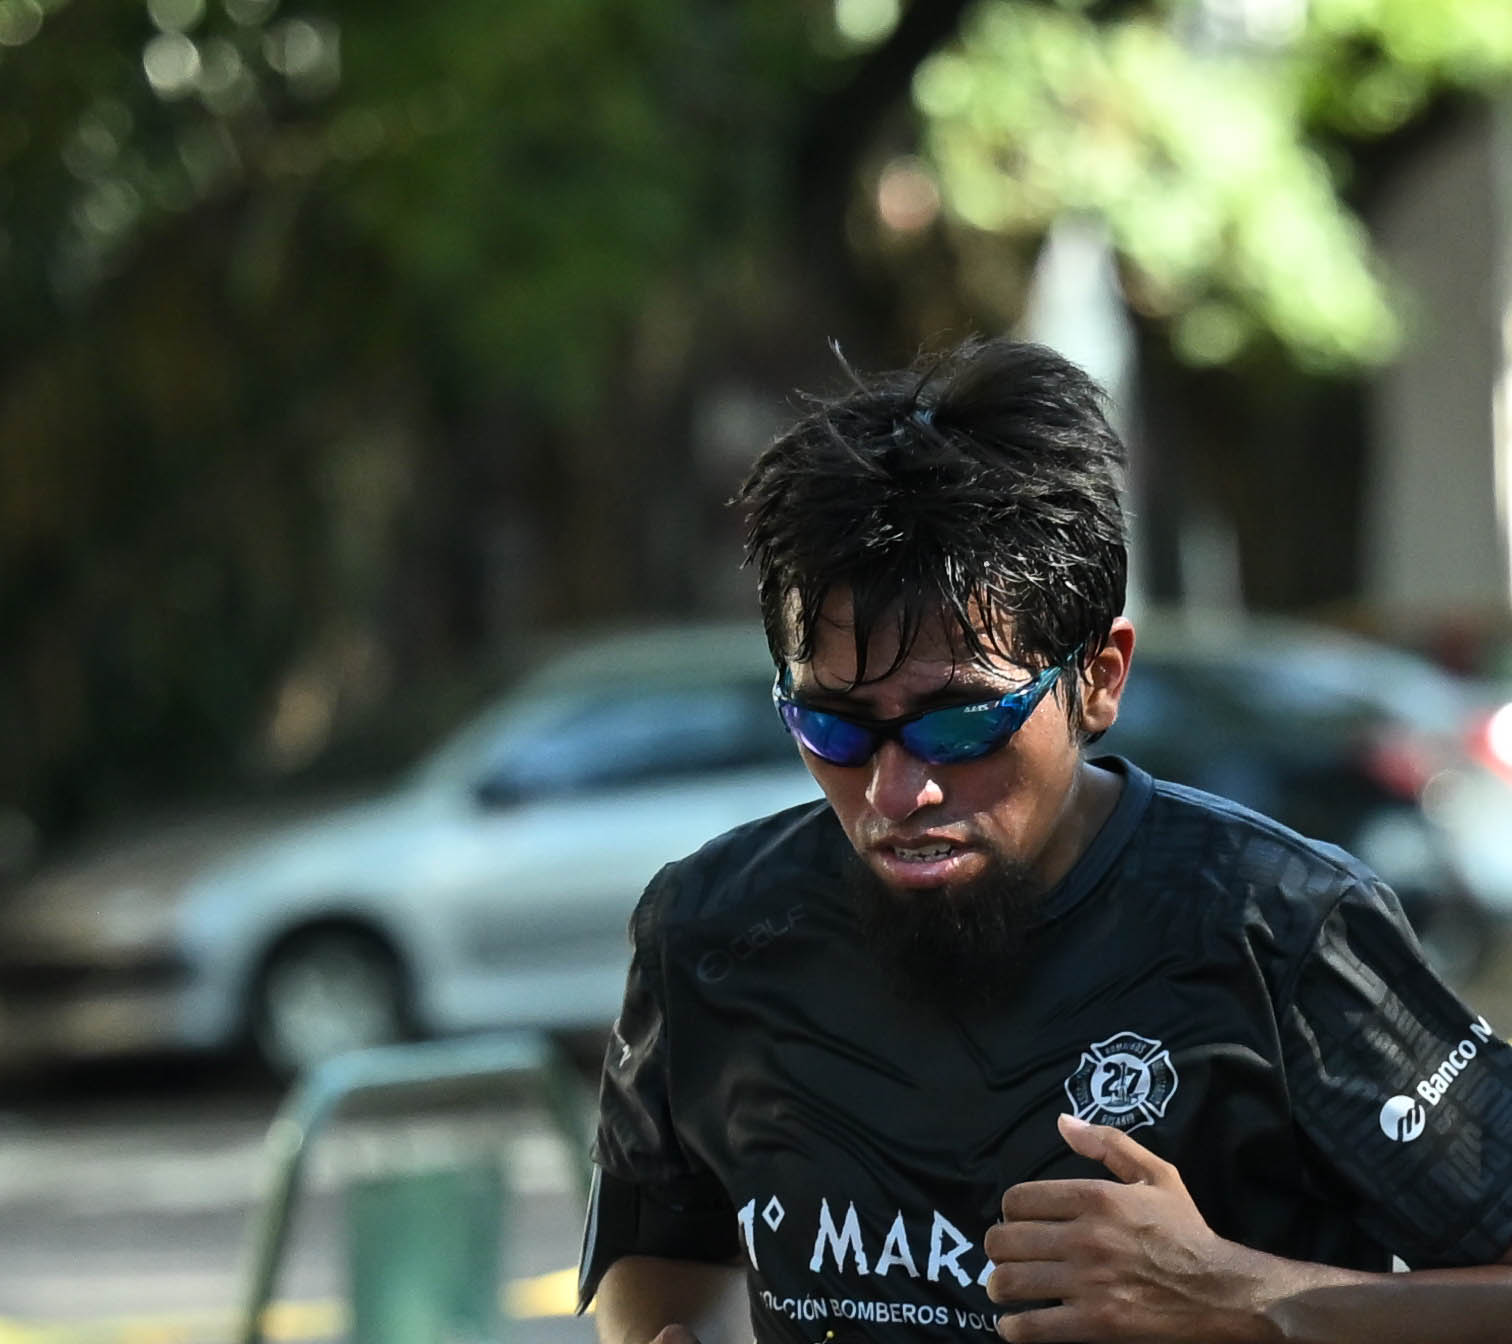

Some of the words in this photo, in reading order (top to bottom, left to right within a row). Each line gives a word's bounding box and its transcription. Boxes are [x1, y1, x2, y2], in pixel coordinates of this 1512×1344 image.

[1100, 1061, 1143, 1098] 27
[1416, 1039, 1477, 1106] Banco
[829, 1298, 949, 1326] BOMBEROS
